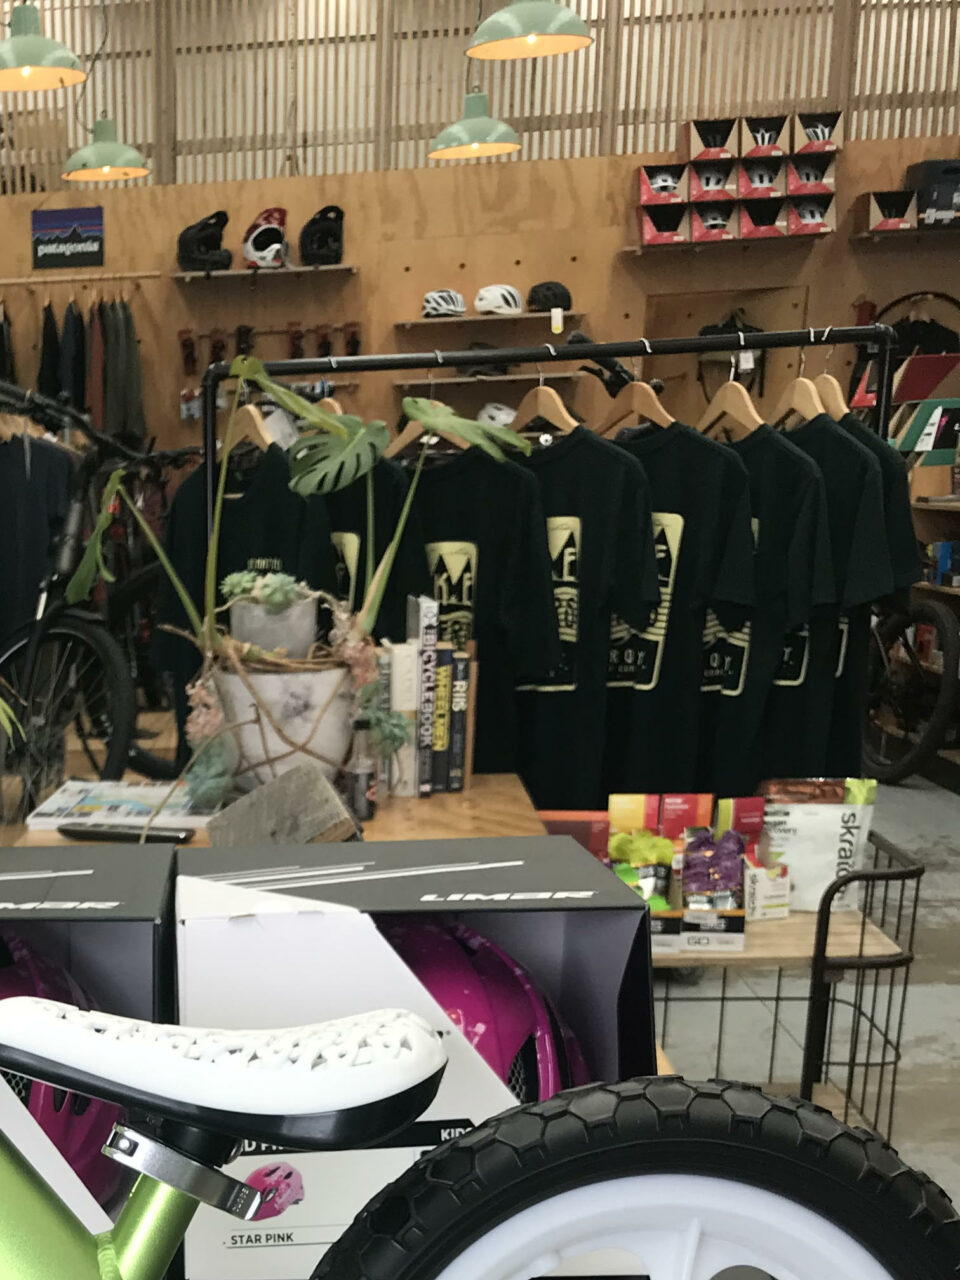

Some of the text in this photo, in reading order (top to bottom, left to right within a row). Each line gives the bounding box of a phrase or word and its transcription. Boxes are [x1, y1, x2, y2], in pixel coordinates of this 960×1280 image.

[421, 635, 437, 703] BICYCLE
[420, 704, 434, 748] BOOK
[231, 1232, 294, 1245] STAR PINK
